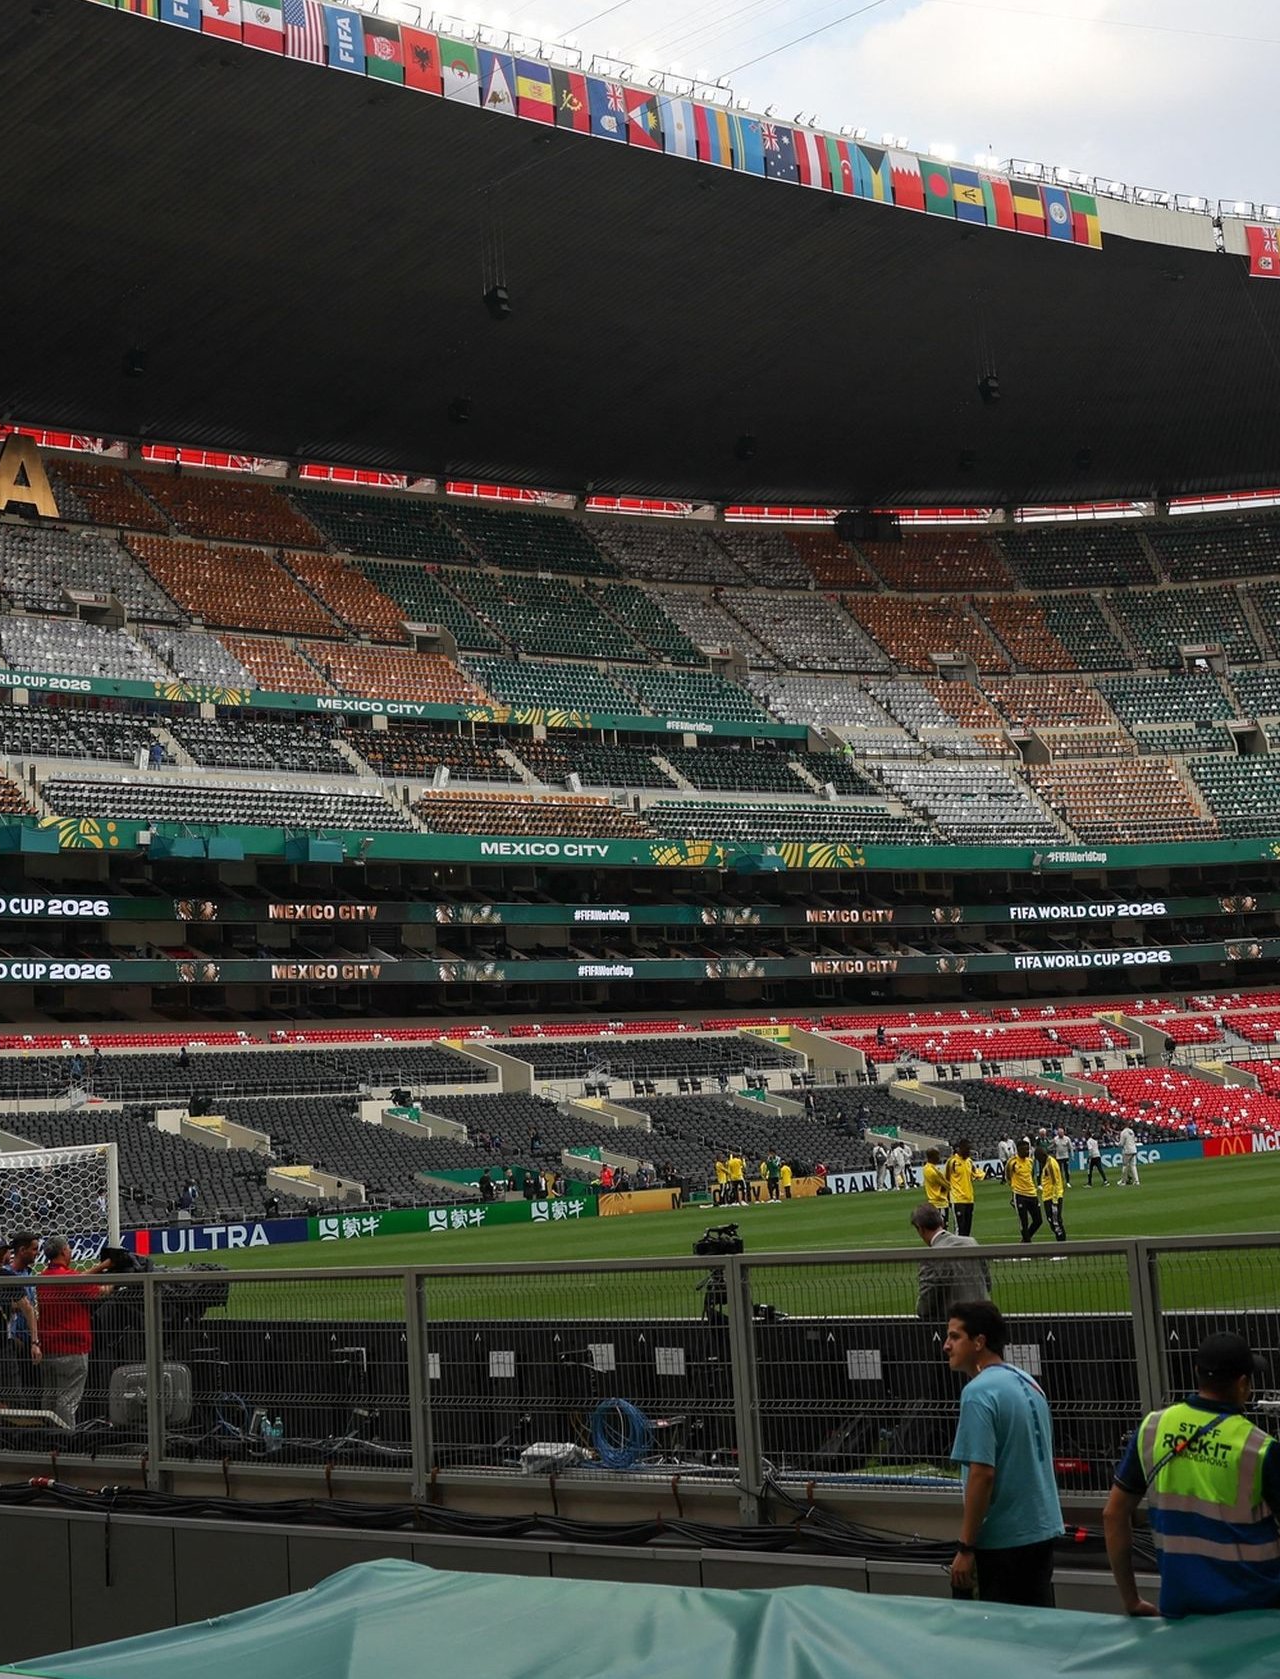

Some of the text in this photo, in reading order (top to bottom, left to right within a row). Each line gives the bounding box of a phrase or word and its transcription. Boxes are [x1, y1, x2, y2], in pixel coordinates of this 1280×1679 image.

[336, 17, 354, 63] FIFA
[23, 674, 46, 688] CUP
[49, 677, 91, 691] 2026
[317, 698, 425, 715] MEXICO CITY
[481, 842, 608, 857] MEXICO CITY
[9, 898, 45, 915] CUP
[48, 899, 110, 916] 2026
[269, 904, 378, 920] MEXICO CITY
[1010, 903, 1167, 919] FIFA WORLD CUP 2026
[574, 910, 630, 922] #FIFAWorldCup
[806, 910, 894, 923] MEXICO CITY
[811, 960, 898, 974] MEXICO CITY
[1015, 951, 1172, 969] FIFA WORLD CUP 2026
[11, 963, 46, 979] CUP
[50, 963, 112, 980] 2026
[272, 964, 381, 979] MEXICO CITY
[578, 965, 634, 977] #FIFAWorldCup
[835, 1174, 875, 1193] BAN
[451, 1207, 486, 1229] 蒙牛
[552, 1200, 584, 1221] 蒙牛
[343, 1216, 380, 1239] 蒙牛
[161, 1223, 269, 1254] ULTRA
